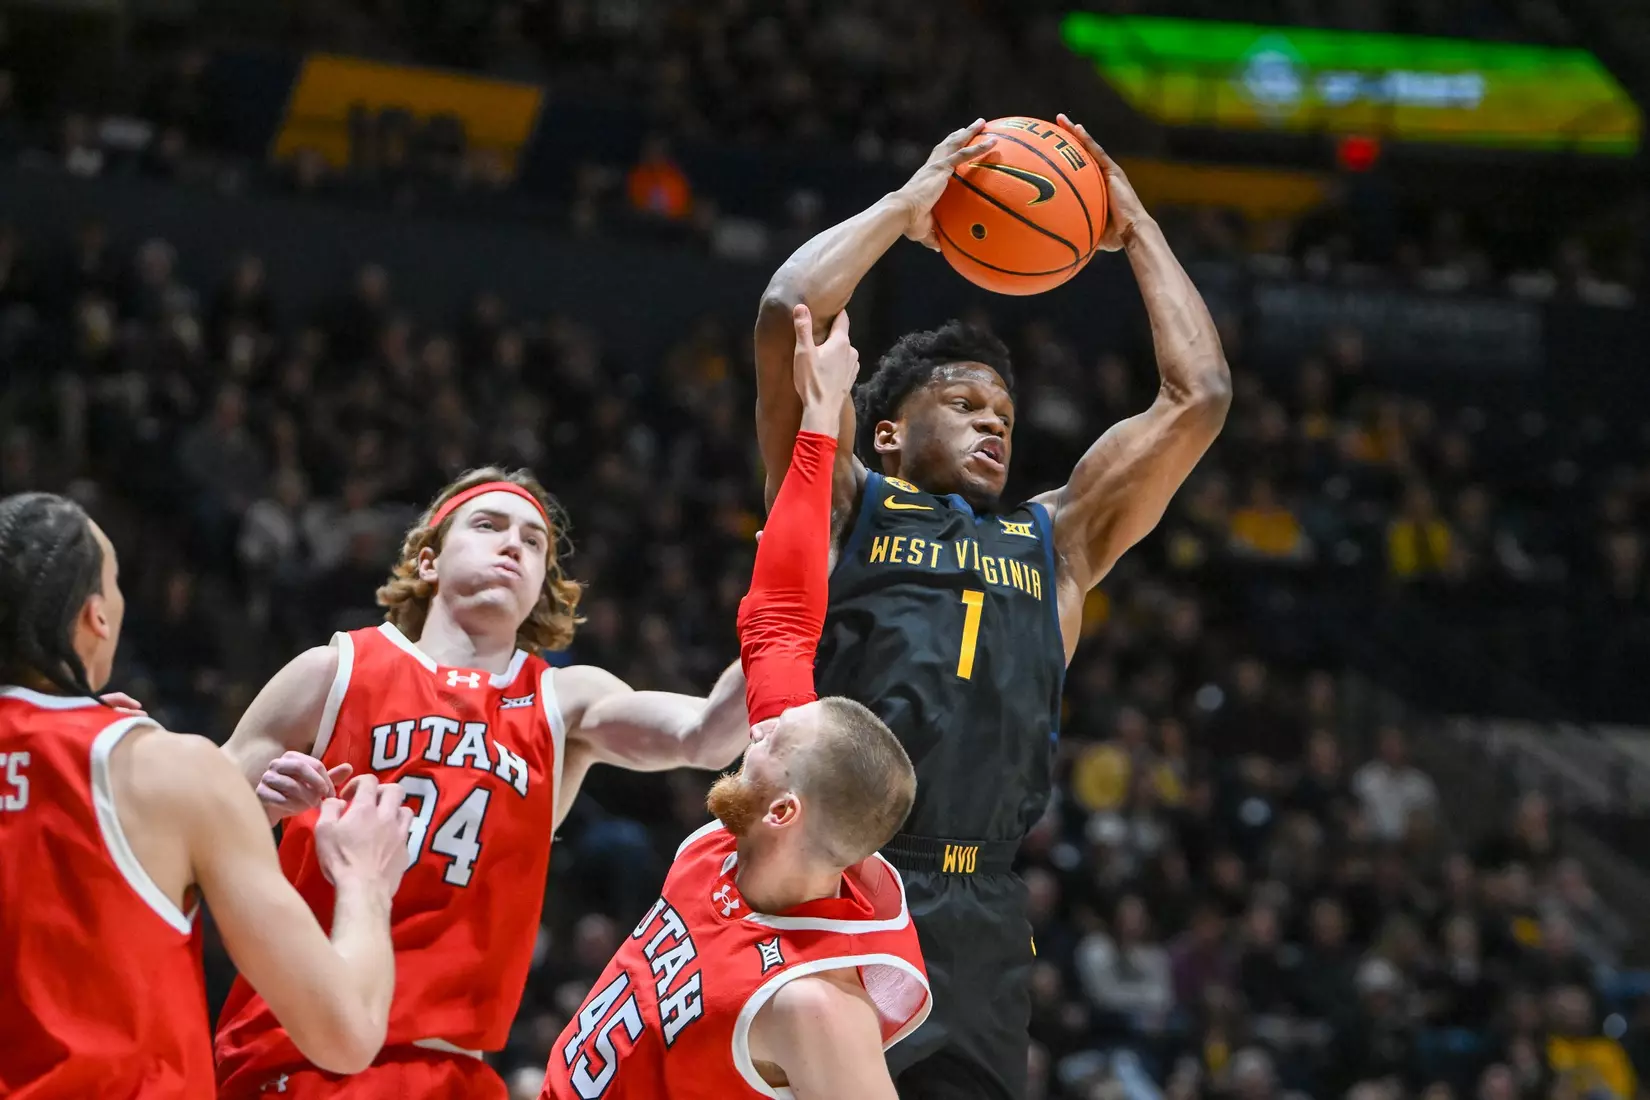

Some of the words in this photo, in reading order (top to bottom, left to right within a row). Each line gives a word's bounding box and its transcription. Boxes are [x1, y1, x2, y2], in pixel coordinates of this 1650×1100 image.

[1004, 120, 1087, 172] ELITE
[869, 536, 943, 569] WEST
[955, 538, 1042, 601] VIGINIA
[956, 589, 984, 679] 1
[0, 751, 31, 812] S
[371, 715, 529, 799] UTAH
[942, 844, 978, 873] WVU
[632, 896, 704, 1050] UTAH
[563, 971, 645, 1100] 45
